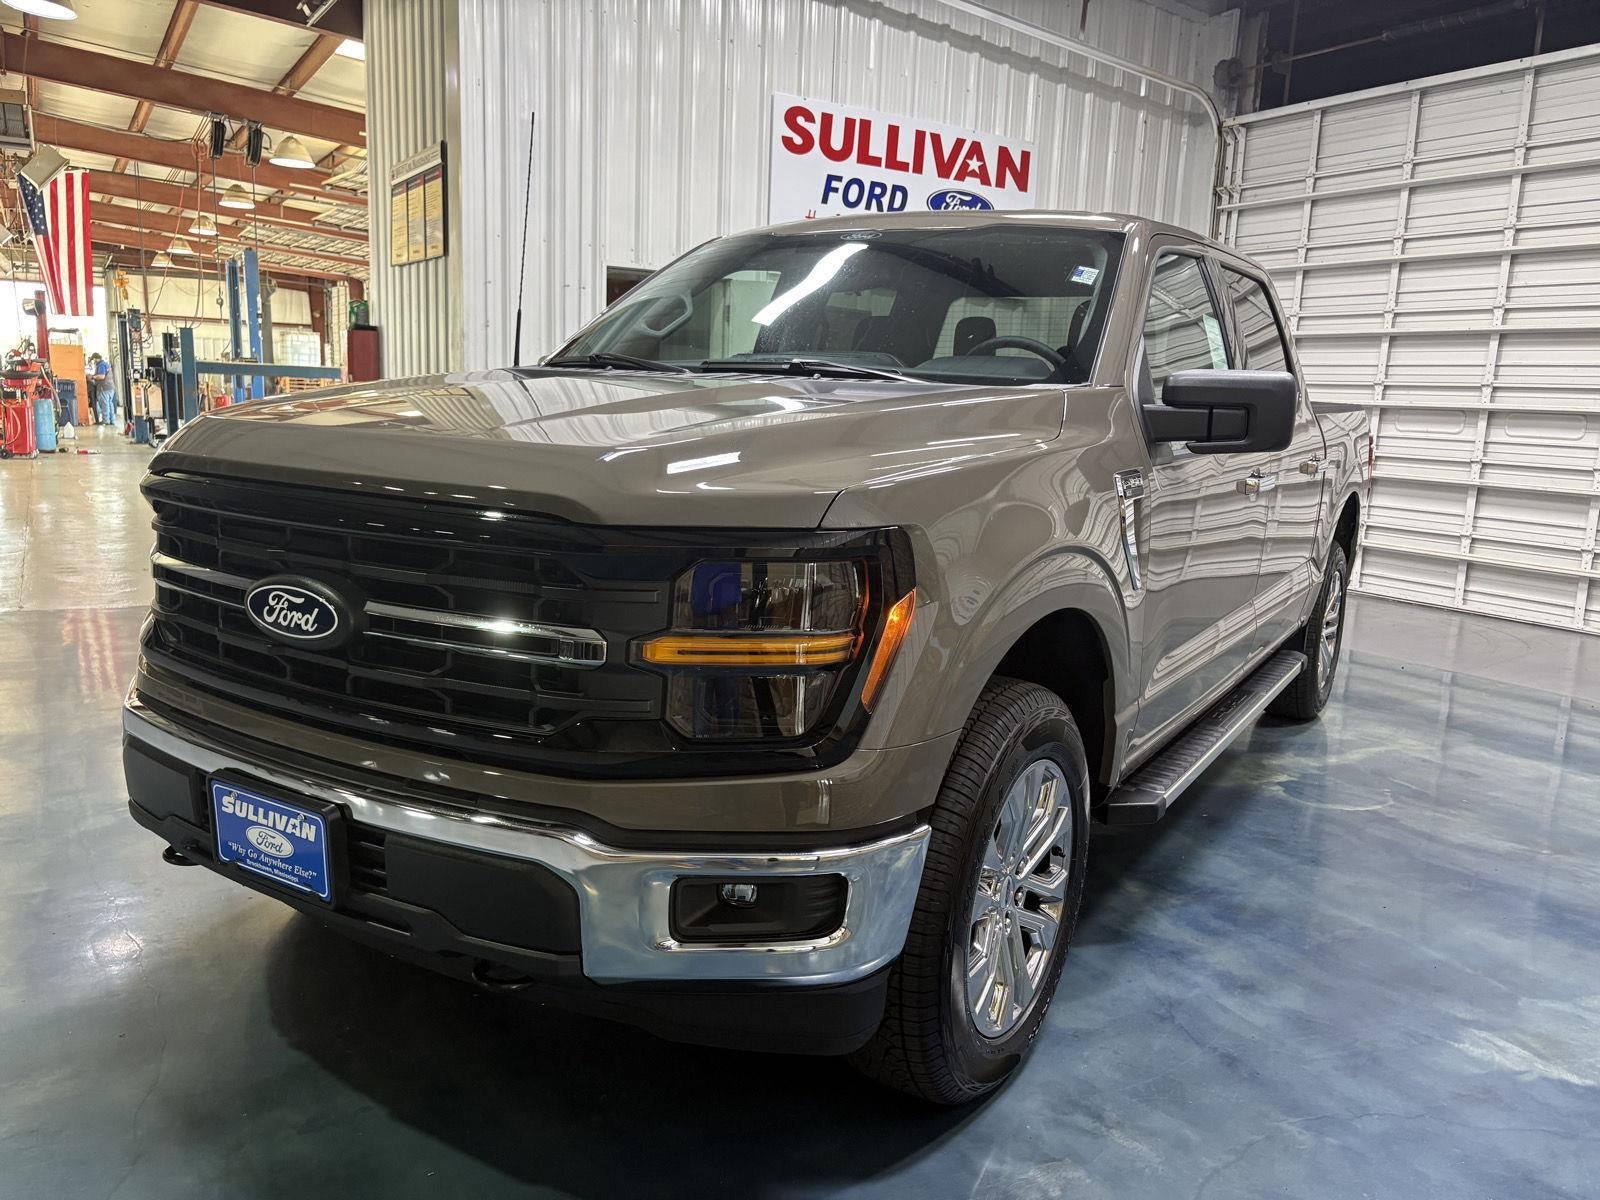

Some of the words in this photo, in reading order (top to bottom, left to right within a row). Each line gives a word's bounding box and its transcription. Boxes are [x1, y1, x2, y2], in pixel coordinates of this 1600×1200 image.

[781, 105, 1031, 193] SULLIVAN
[821, 173, 908, 212] FORD
[263, 591, 319, 632] Ford
[221, 795, 317, 843] SULLIVAN
[247, 848, 258, 860] Go
[259, 853, 293, 872] Anywhere
[256, 830, 284, 854] Ford
